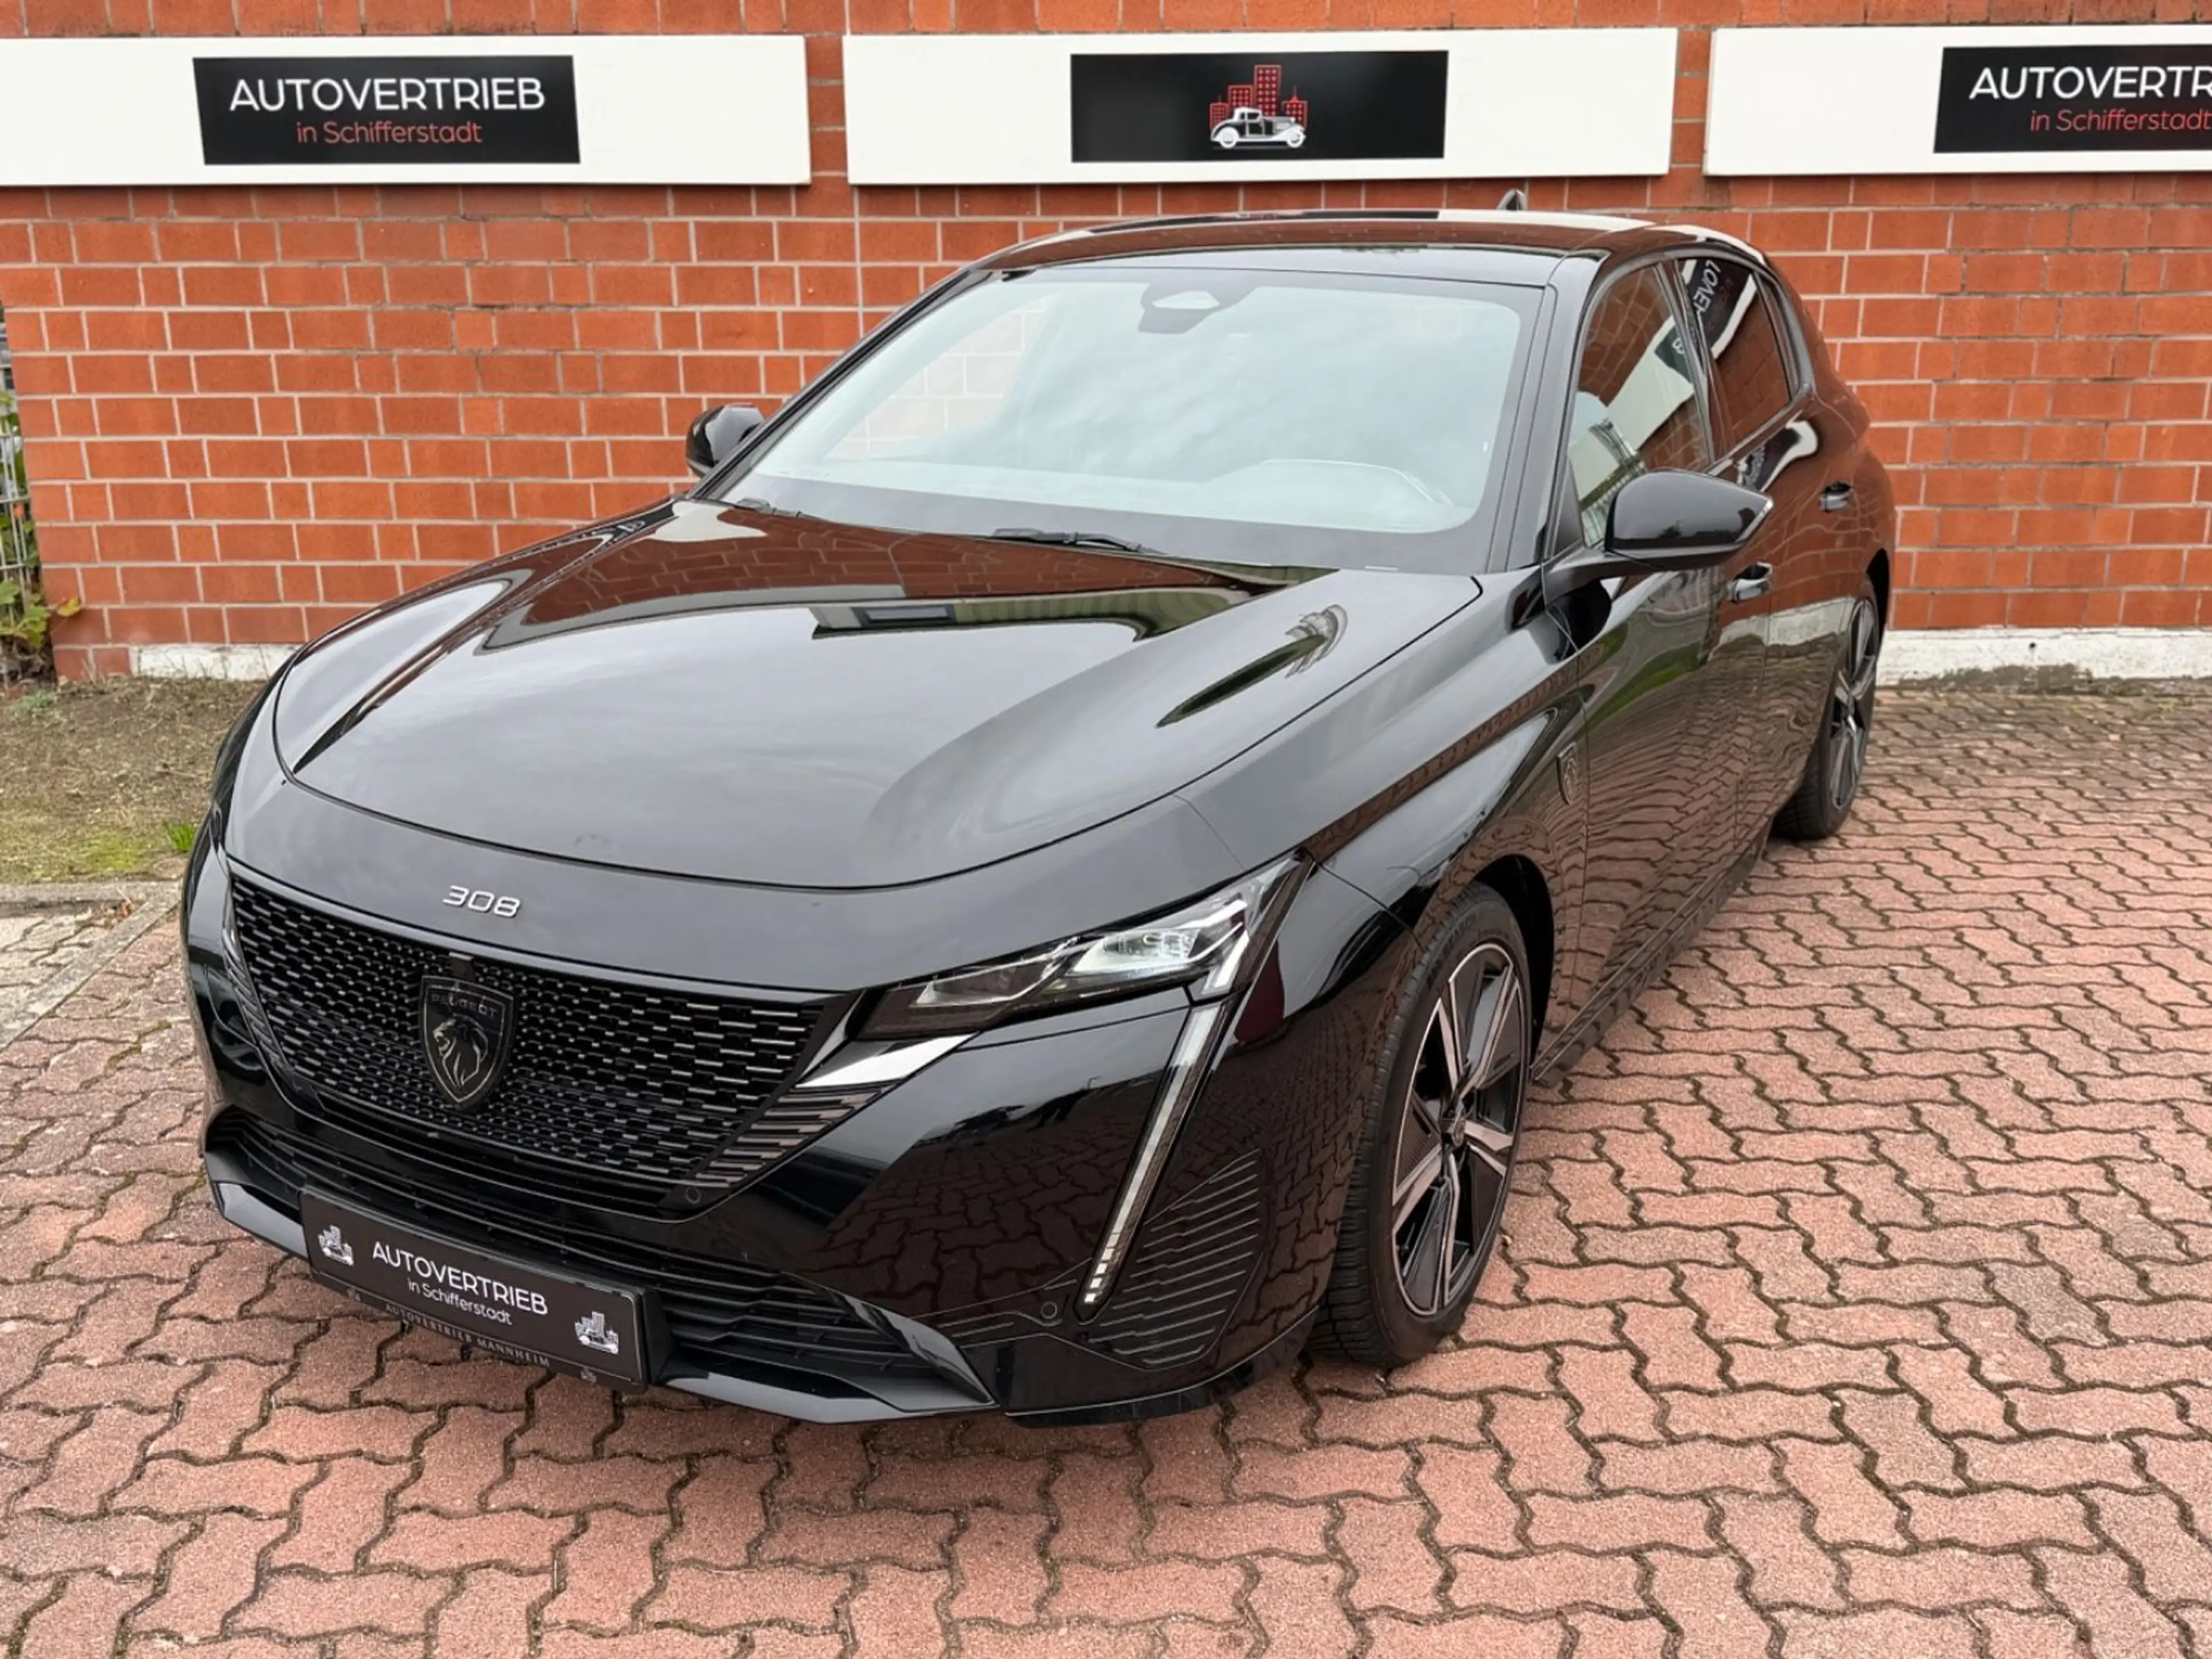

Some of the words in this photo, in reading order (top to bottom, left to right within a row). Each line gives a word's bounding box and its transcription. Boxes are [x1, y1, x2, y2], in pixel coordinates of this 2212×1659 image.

[230, 77, 546, 112] AUTOVERTRIEB
[297, 122, 316, 143] in
[323, 120, 483, 144] Schifferstadt
[2029, 110, 2050, 132] in
[2056, 108, 2212, 131] Schifferstadt
[442, 884, 521, 918] 308
[431, 993, 498, 1018] PEUGEOT
[373, 1241, 548, 1315] AUTOVERTRIEB
[408, 1278, 421, 1294] in
[422, 1282, 513, 1325] Schifferstadt
[385, 1304, 472, 1343] AUTOVERTRIEB
[476, 1338, 550, 1367] MANNHEIM
